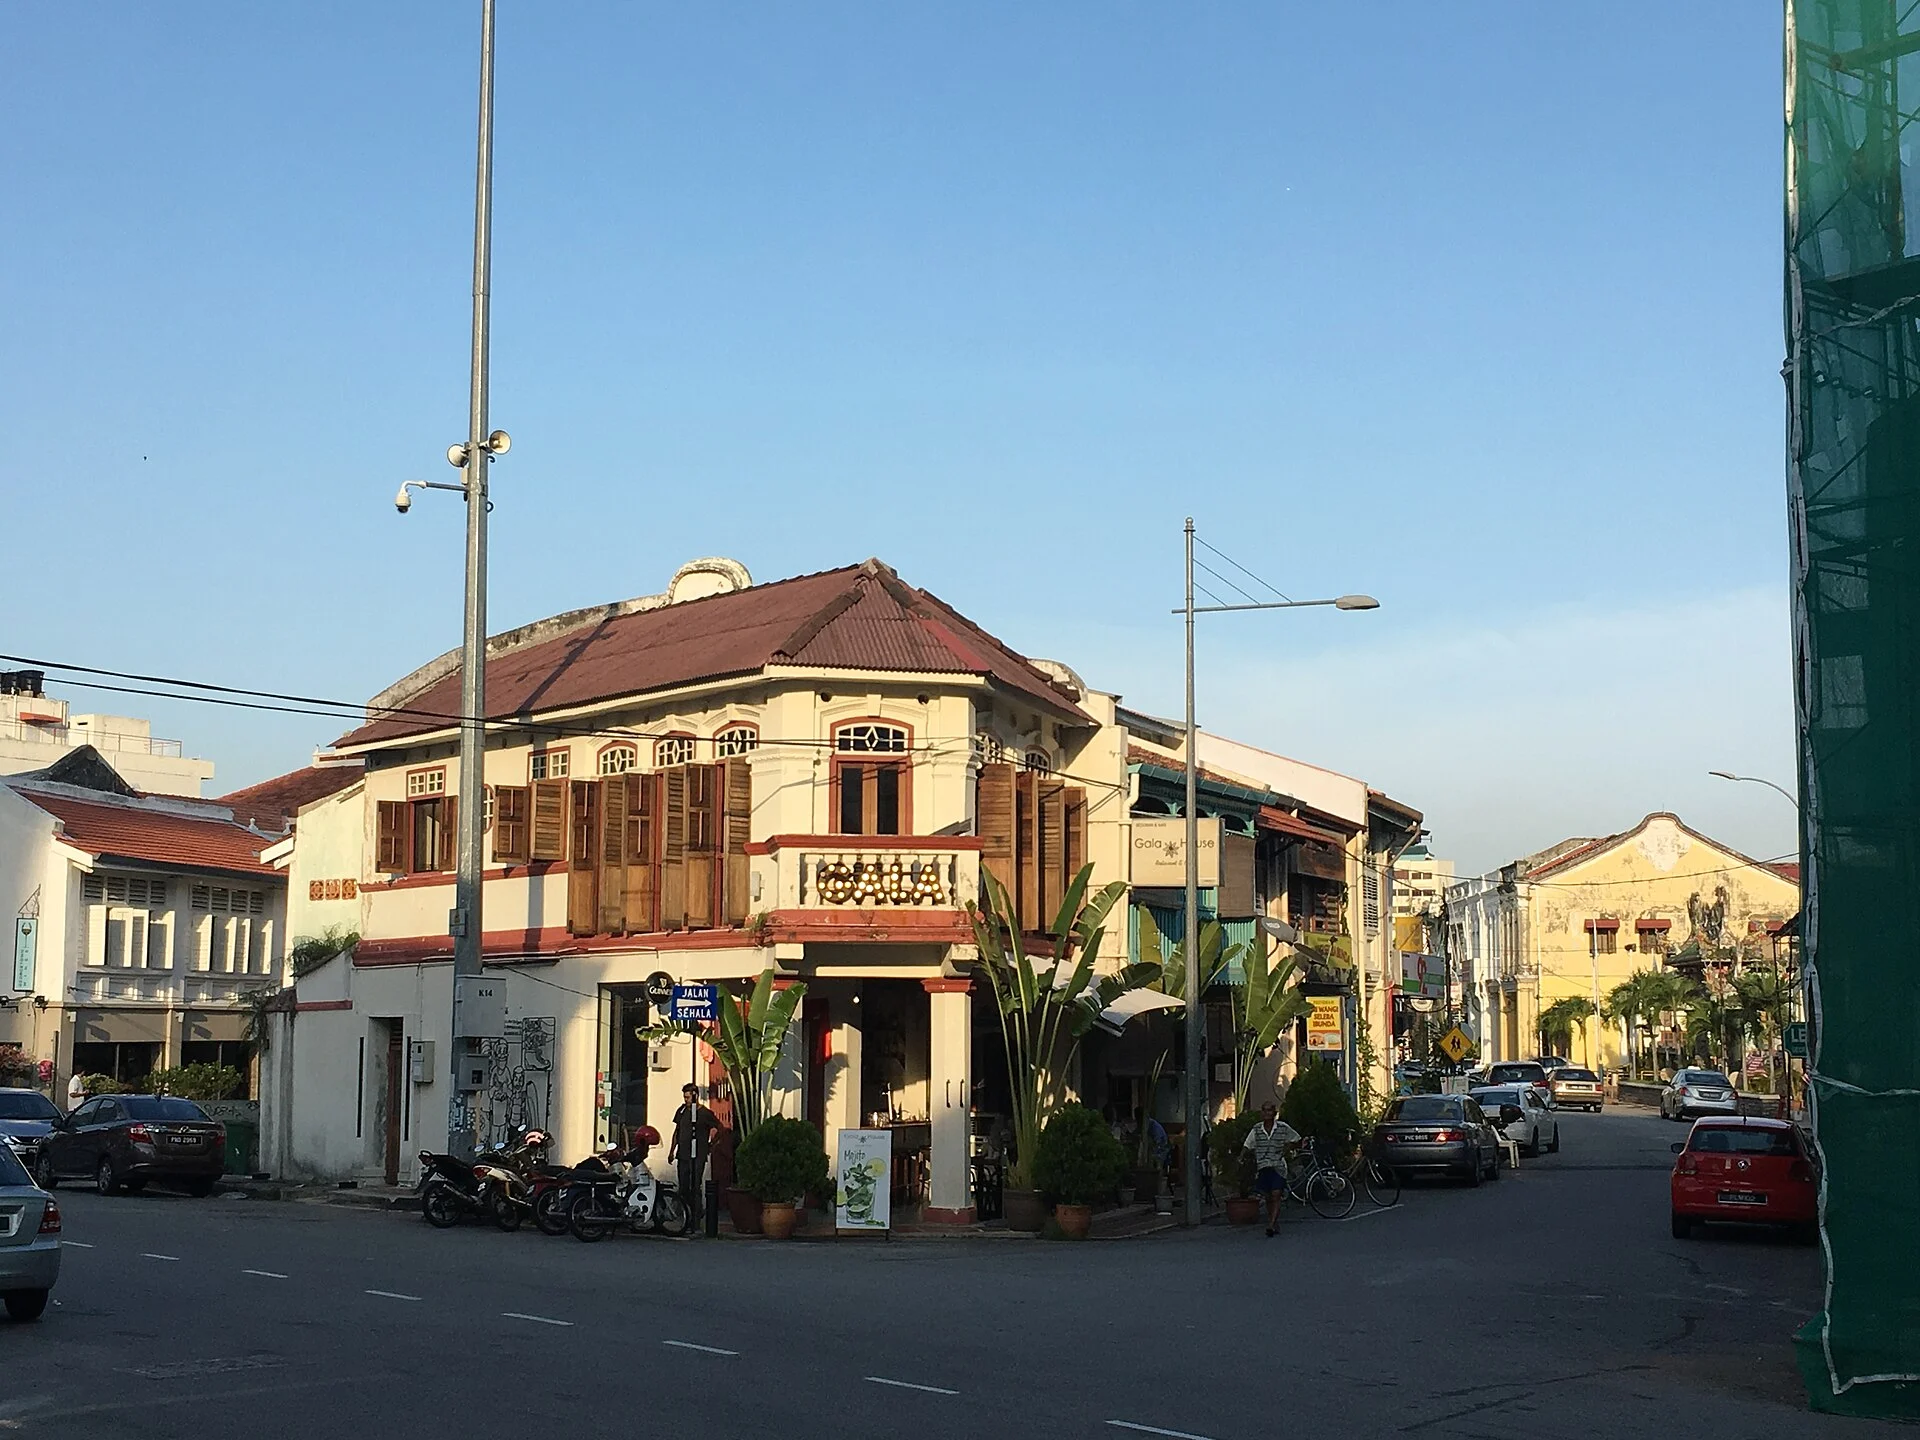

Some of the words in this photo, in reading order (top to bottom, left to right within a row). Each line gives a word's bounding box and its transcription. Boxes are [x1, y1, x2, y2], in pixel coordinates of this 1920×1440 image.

[1134, 838, 1162, 849] Gala
[1180, 838, 1214, 849] Huse
[816, 862, 946, 905] GALA
[478, 989, 493, 997] K14
[681, 988, 709, 998] JALAN
[677, 1007, 712, 1018] SEHALA
